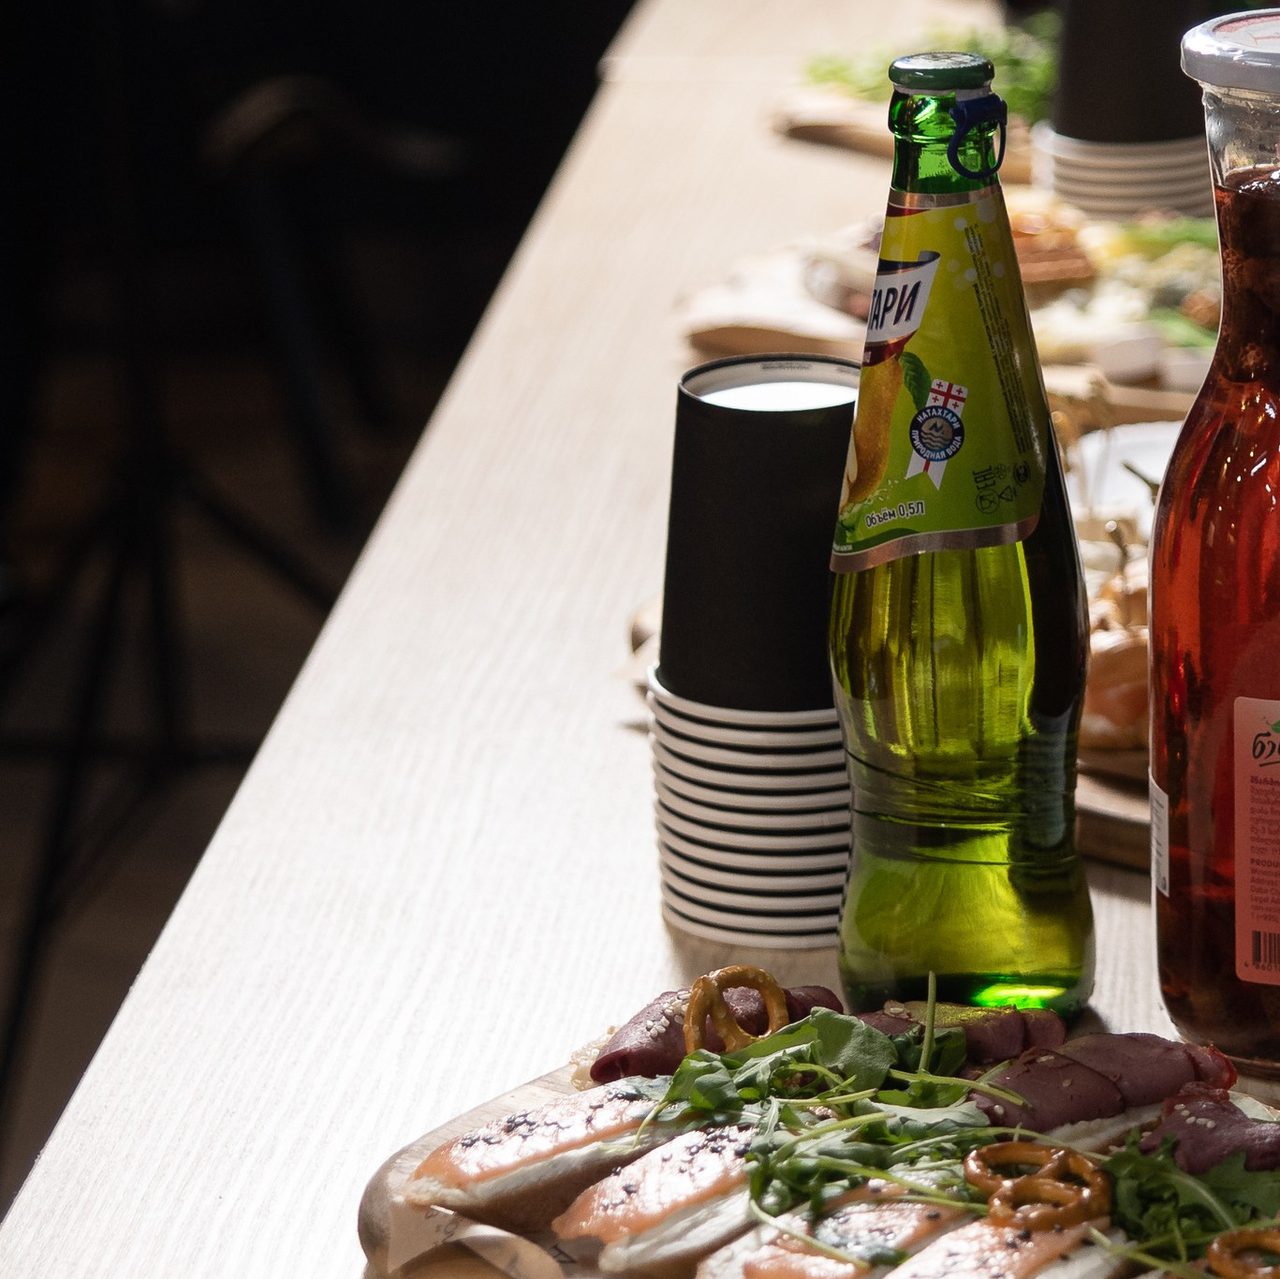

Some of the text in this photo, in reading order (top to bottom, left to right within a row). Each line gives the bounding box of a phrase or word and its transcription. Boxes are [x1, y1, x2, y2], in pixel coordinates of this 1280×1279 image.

[916, 408, 962, 430] НАТАХТАРИ
[911, 429, 962, 460] ПРИРОДНАЯ ВОДА
[865, 508, 896, 528] Объём
